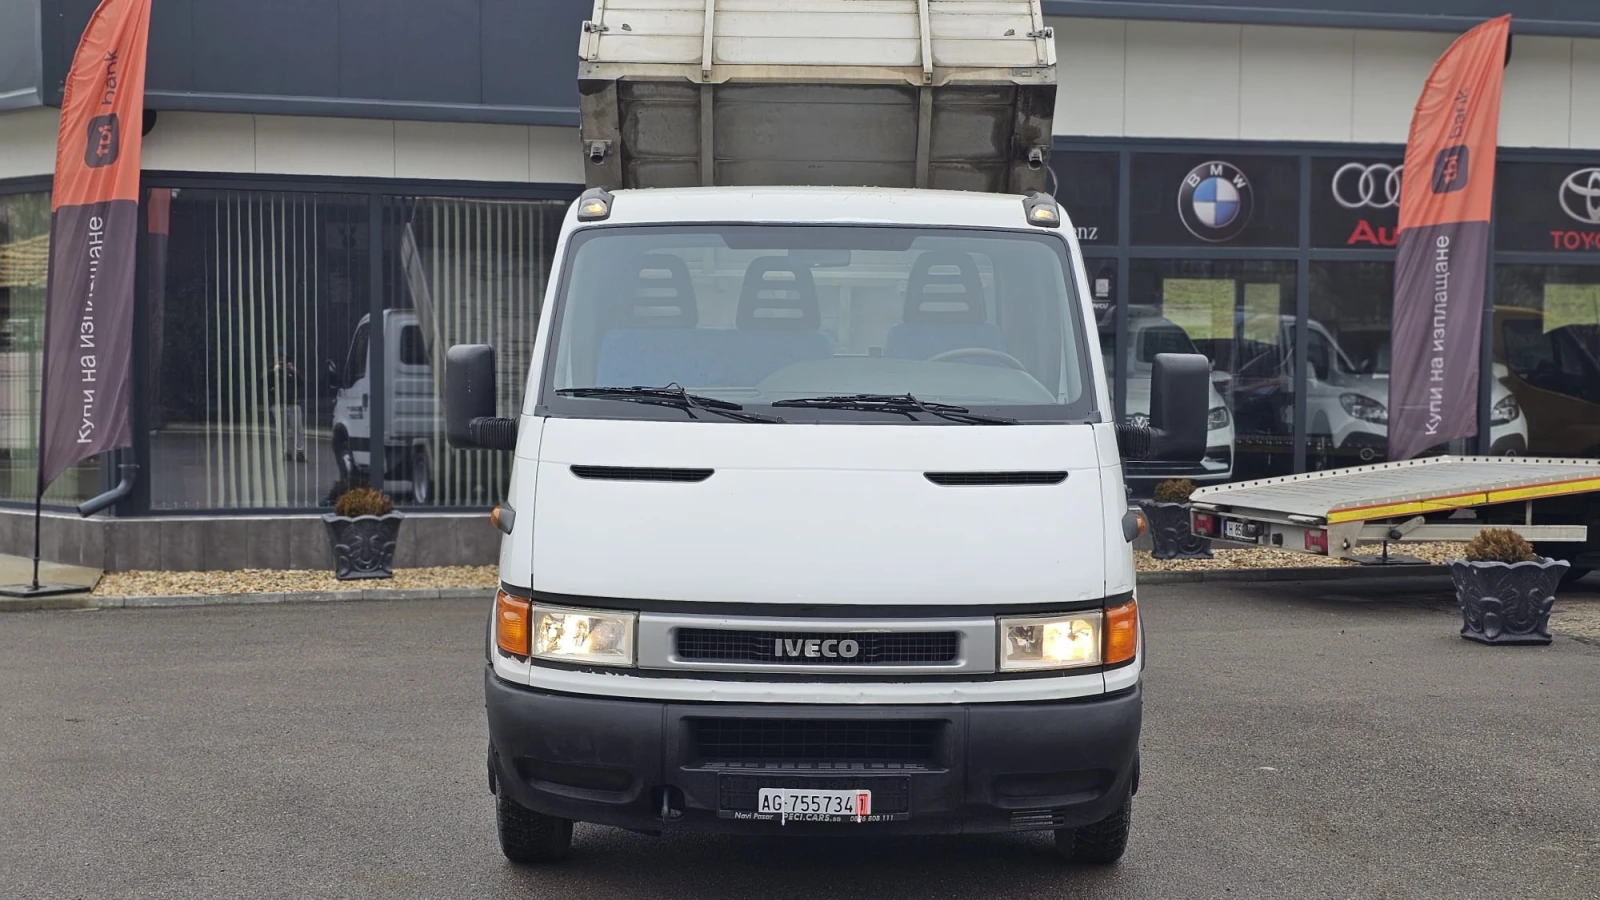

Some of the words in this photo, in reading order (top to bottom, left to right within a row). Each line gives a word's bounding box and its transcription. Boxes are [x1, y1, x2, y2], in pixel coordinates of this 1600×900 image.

[1187, 164, 1247, 190] BMW
[1432, 235, 1450, 351] изплащане
[80, 355, 96, 382] на
[1430, 357, 1443, 381] на
[77, 390, 95, 443] Купи
[1425, 387, 1443, 435] Купи
[775, 639, 859, 658] IVECO
[734, 811, 752, 820] Navi
[753, 813, 774, 821] Pazar
[882, 814, 894, 822] 111
